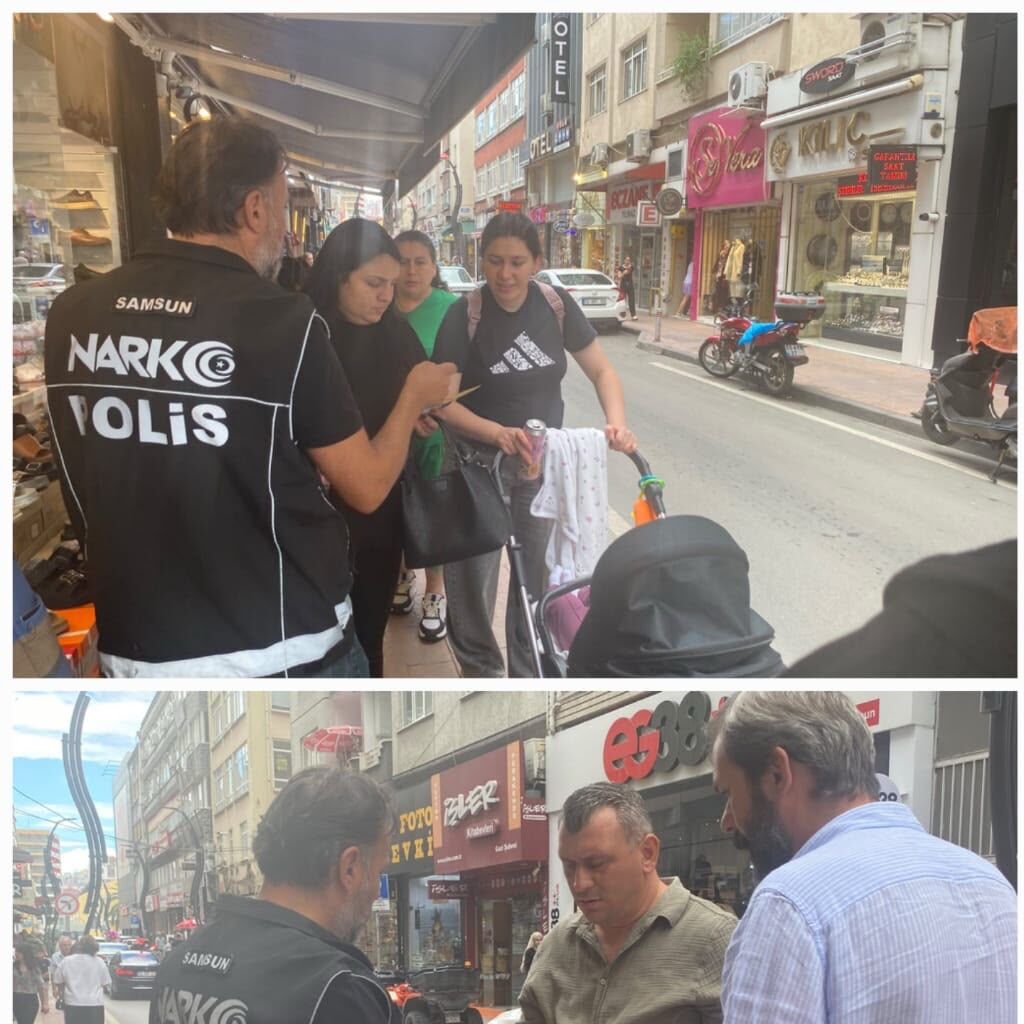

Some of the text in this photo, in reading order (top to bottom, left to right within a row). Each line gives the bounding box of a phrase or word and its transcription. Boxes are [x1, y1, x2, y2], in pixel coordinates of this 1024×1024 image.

[115, 297, 192, 315] SAMSUN
[400, 806, 434, 834] FOTO
[182, 952, 231, 973] SAMSUN
